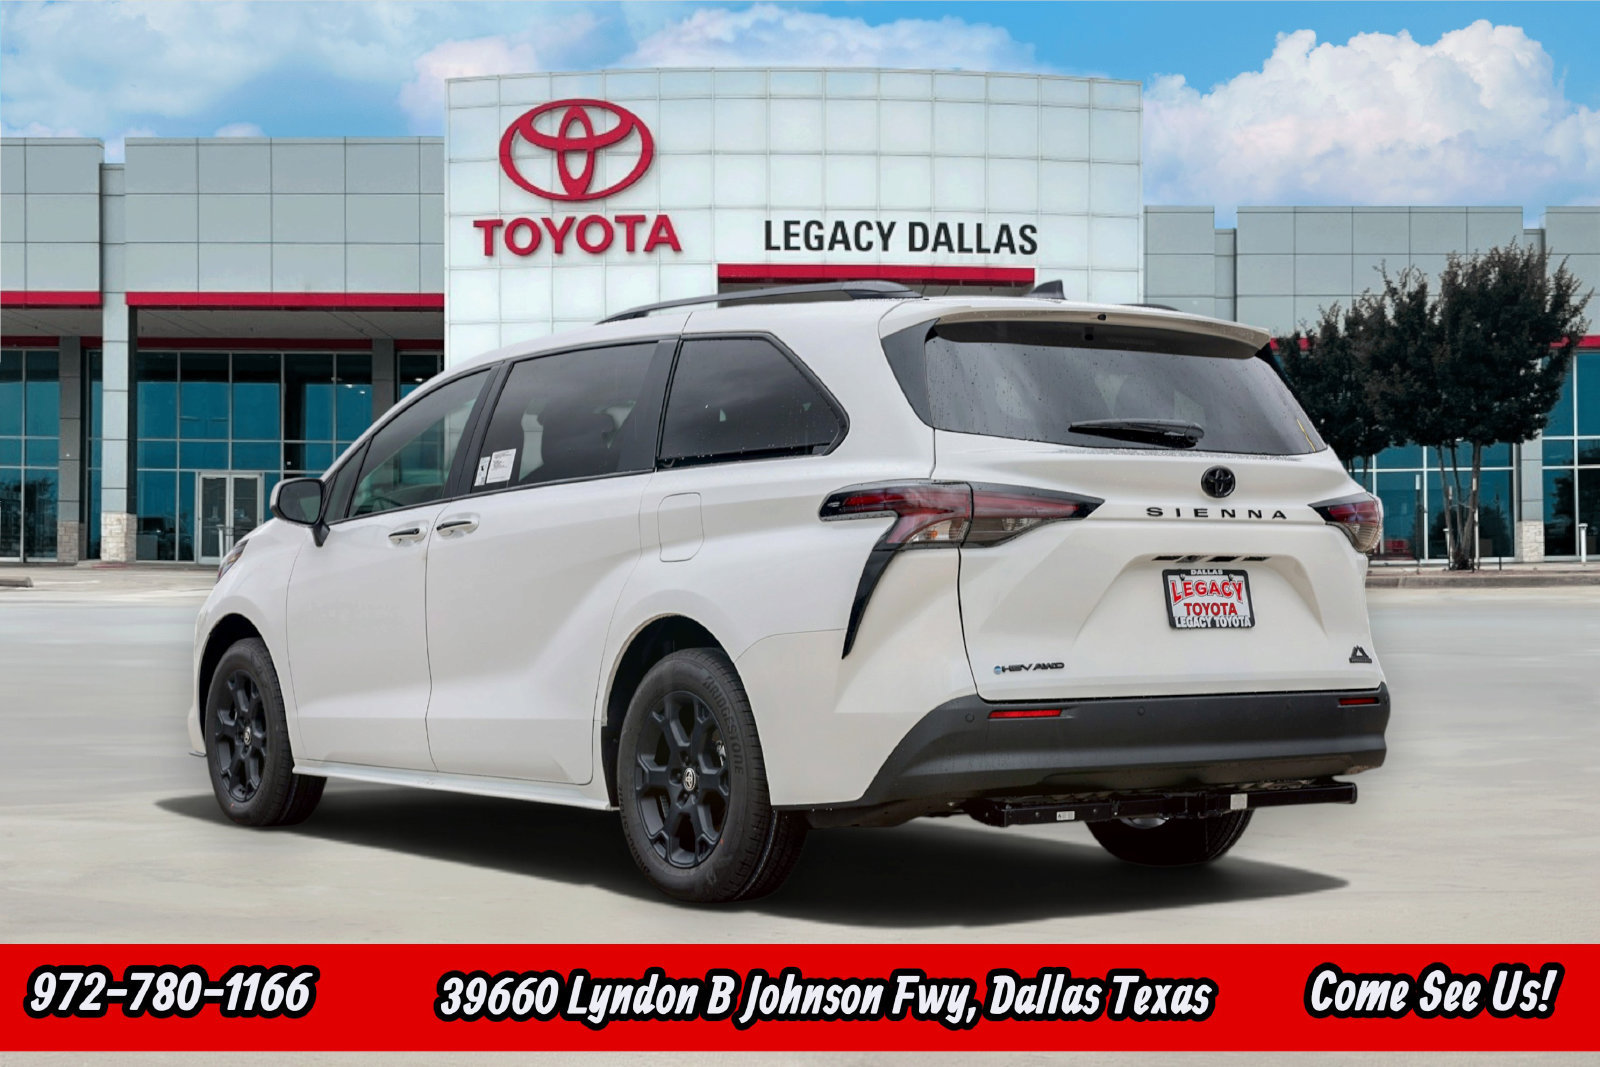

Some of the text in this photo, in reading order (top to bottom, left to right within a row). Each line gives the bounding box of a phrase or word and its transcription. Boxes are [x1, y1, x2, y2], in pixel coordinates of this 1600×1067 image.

[473, 214, 682, 256] TOYOTA
[764, 220, 1039, 255] LEGACY DALLAS
[1146, 506, 1287, 520] SIENNA
[1170, 580, 1244, 605] LEGACY
[1183, 602, 1238, 616] TOYOTA
[1173, 616, 1252, 628] LEGACY TOYOTA
[703, 675, 744, 775] BRIDGESTONE
